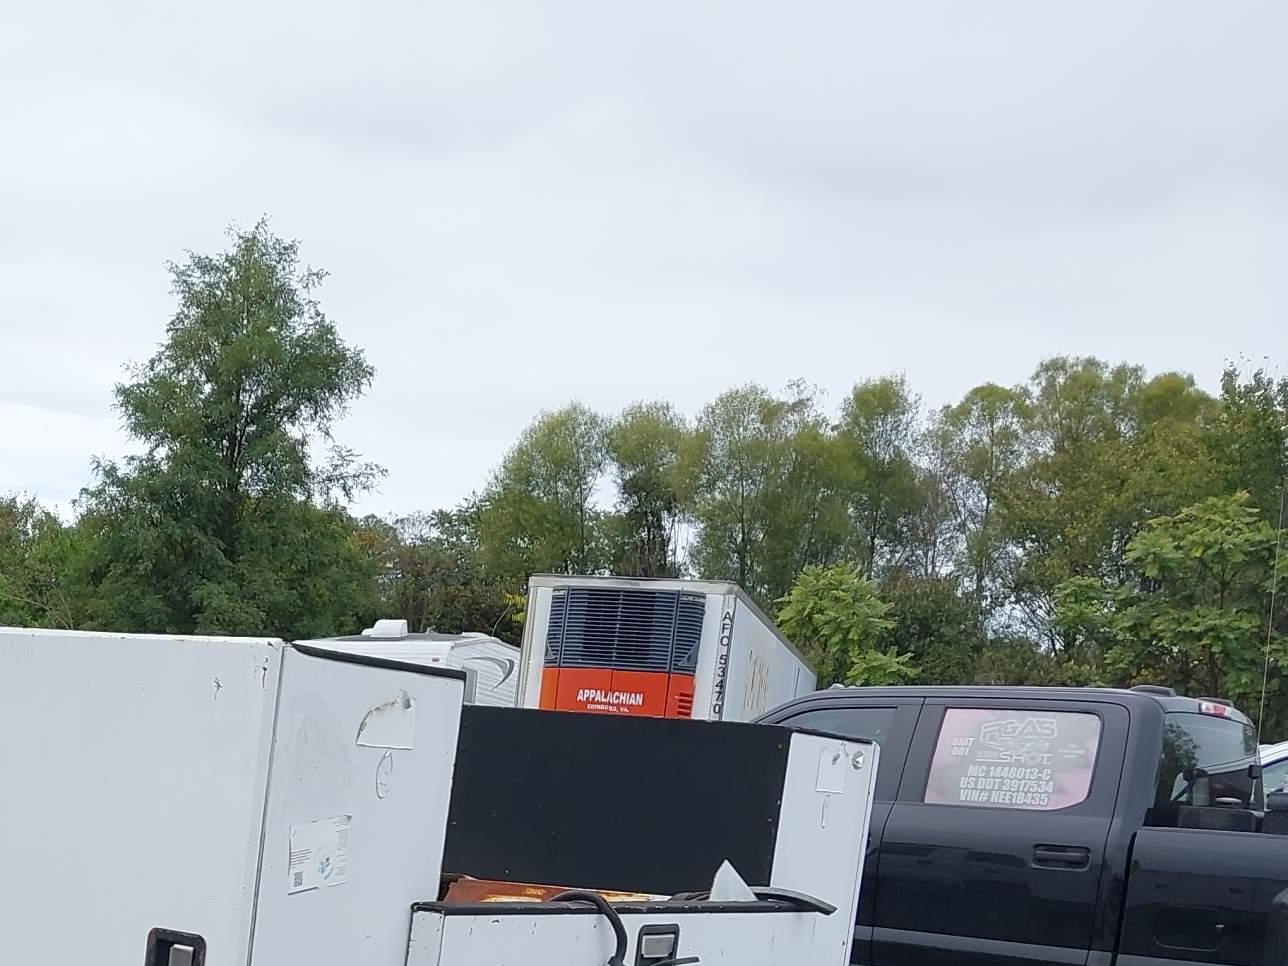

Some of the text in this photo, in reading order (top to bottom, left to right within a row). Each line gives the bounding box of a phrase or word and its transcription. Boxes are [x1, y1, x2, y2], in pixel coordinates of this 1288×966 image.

[713, 654, 728, 715] 53470
[576, 689, 643, 706] APPALACHIAN
[968, 765, 987, 777] MC
[960, 777, 976, 789] US
[977, 778, 1002, 791] DOT
[960, 789, 989, 802] VIN#
